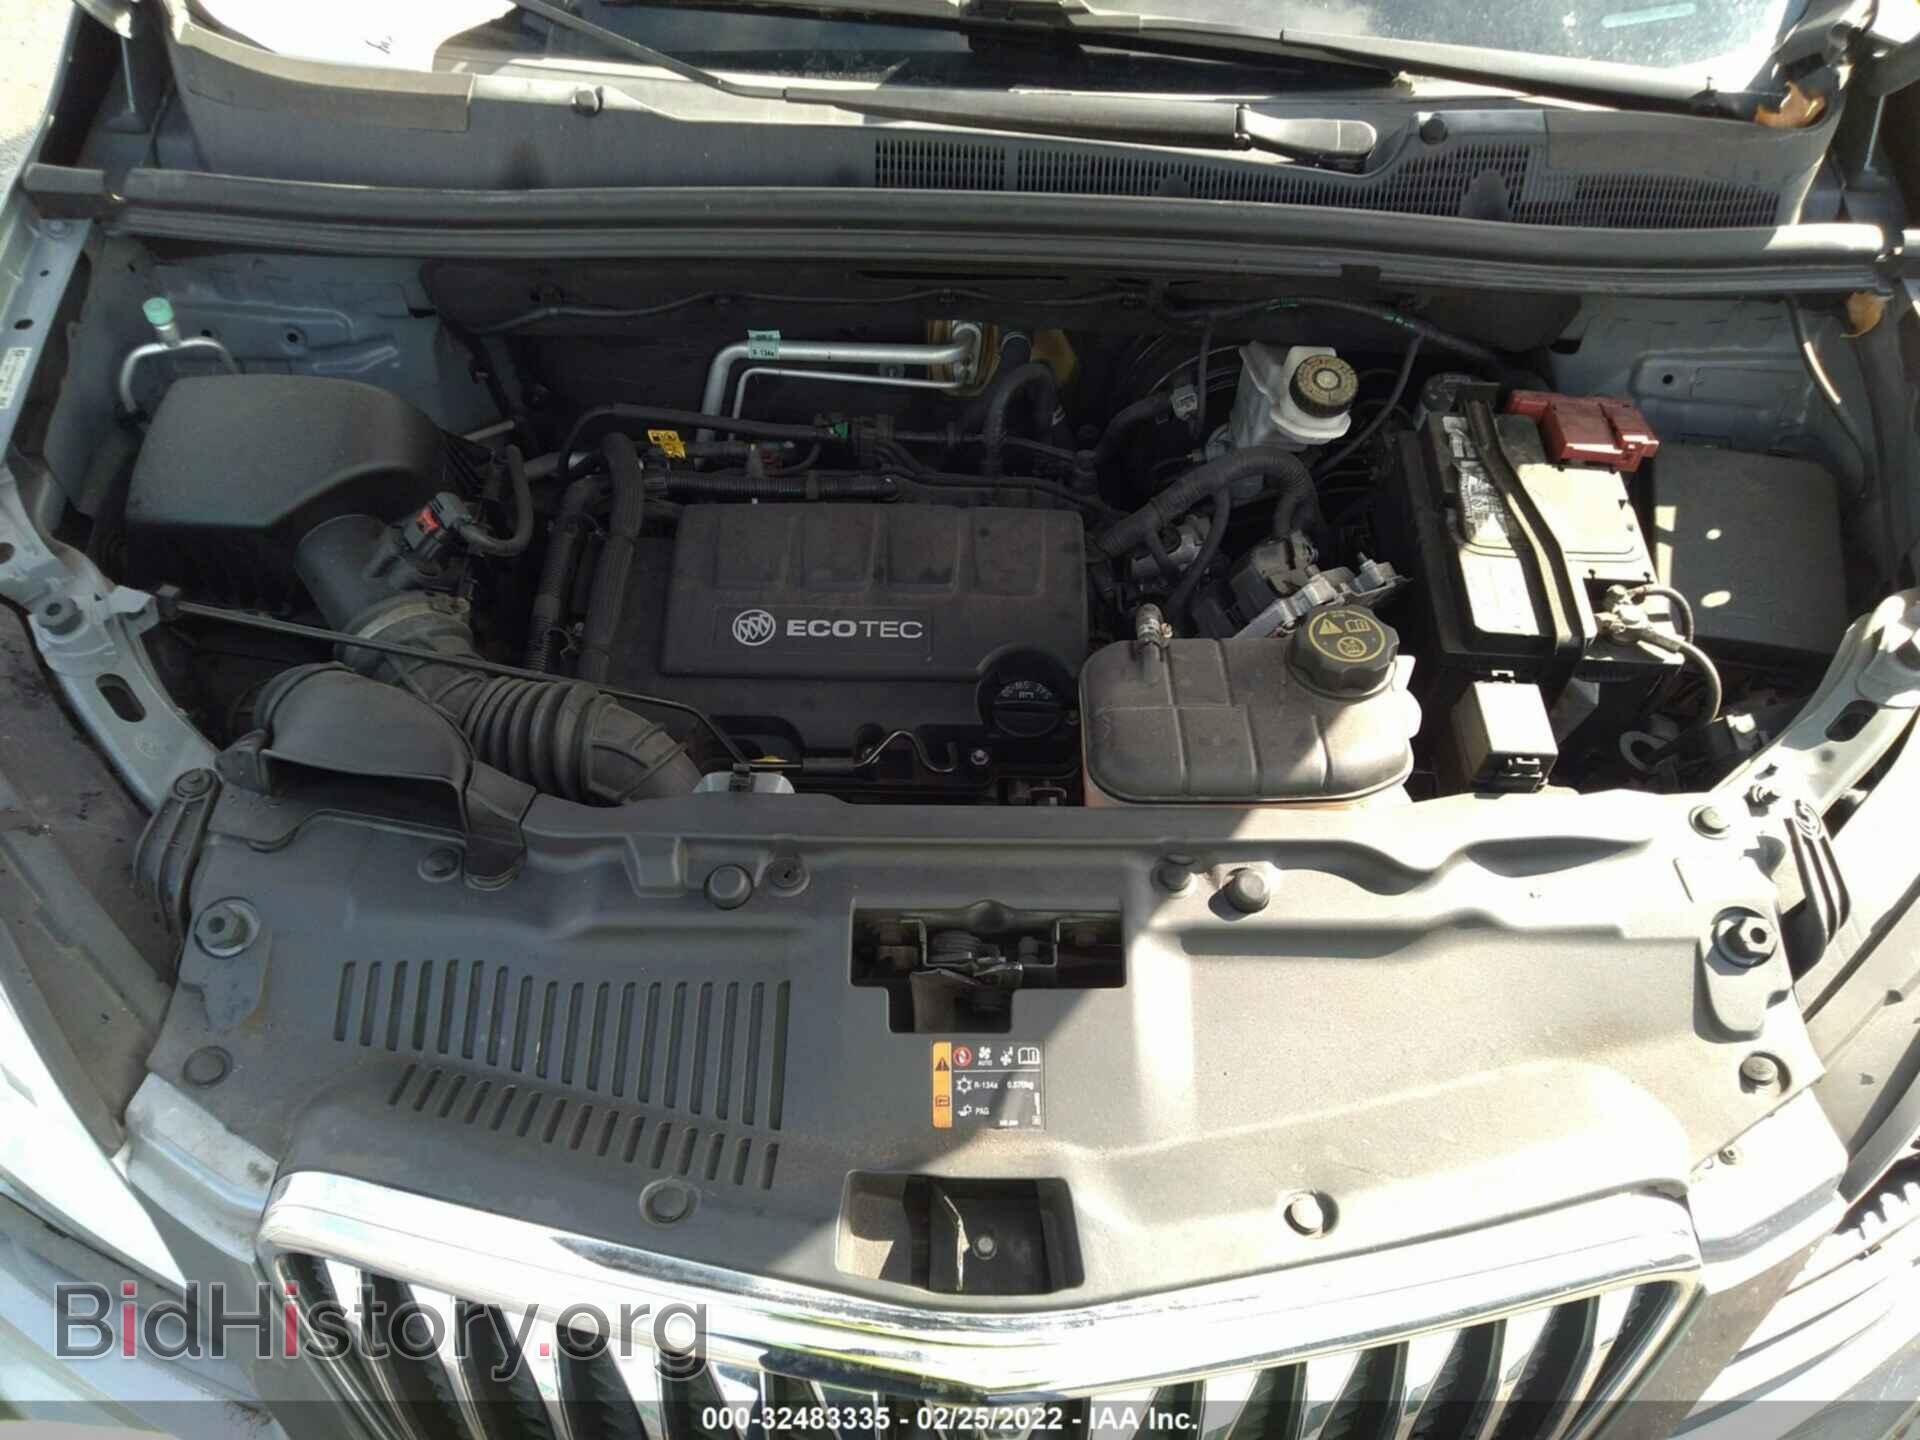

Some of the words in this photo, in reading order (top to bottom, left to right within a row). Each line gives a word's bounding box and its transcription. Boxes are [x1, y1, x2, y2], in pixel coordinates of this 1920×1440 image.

[786, 619, 923, 639] ECOTEC
[977, 1059, 993, 1067] AUTO
[975, 1106, 990, 1116] PAG
